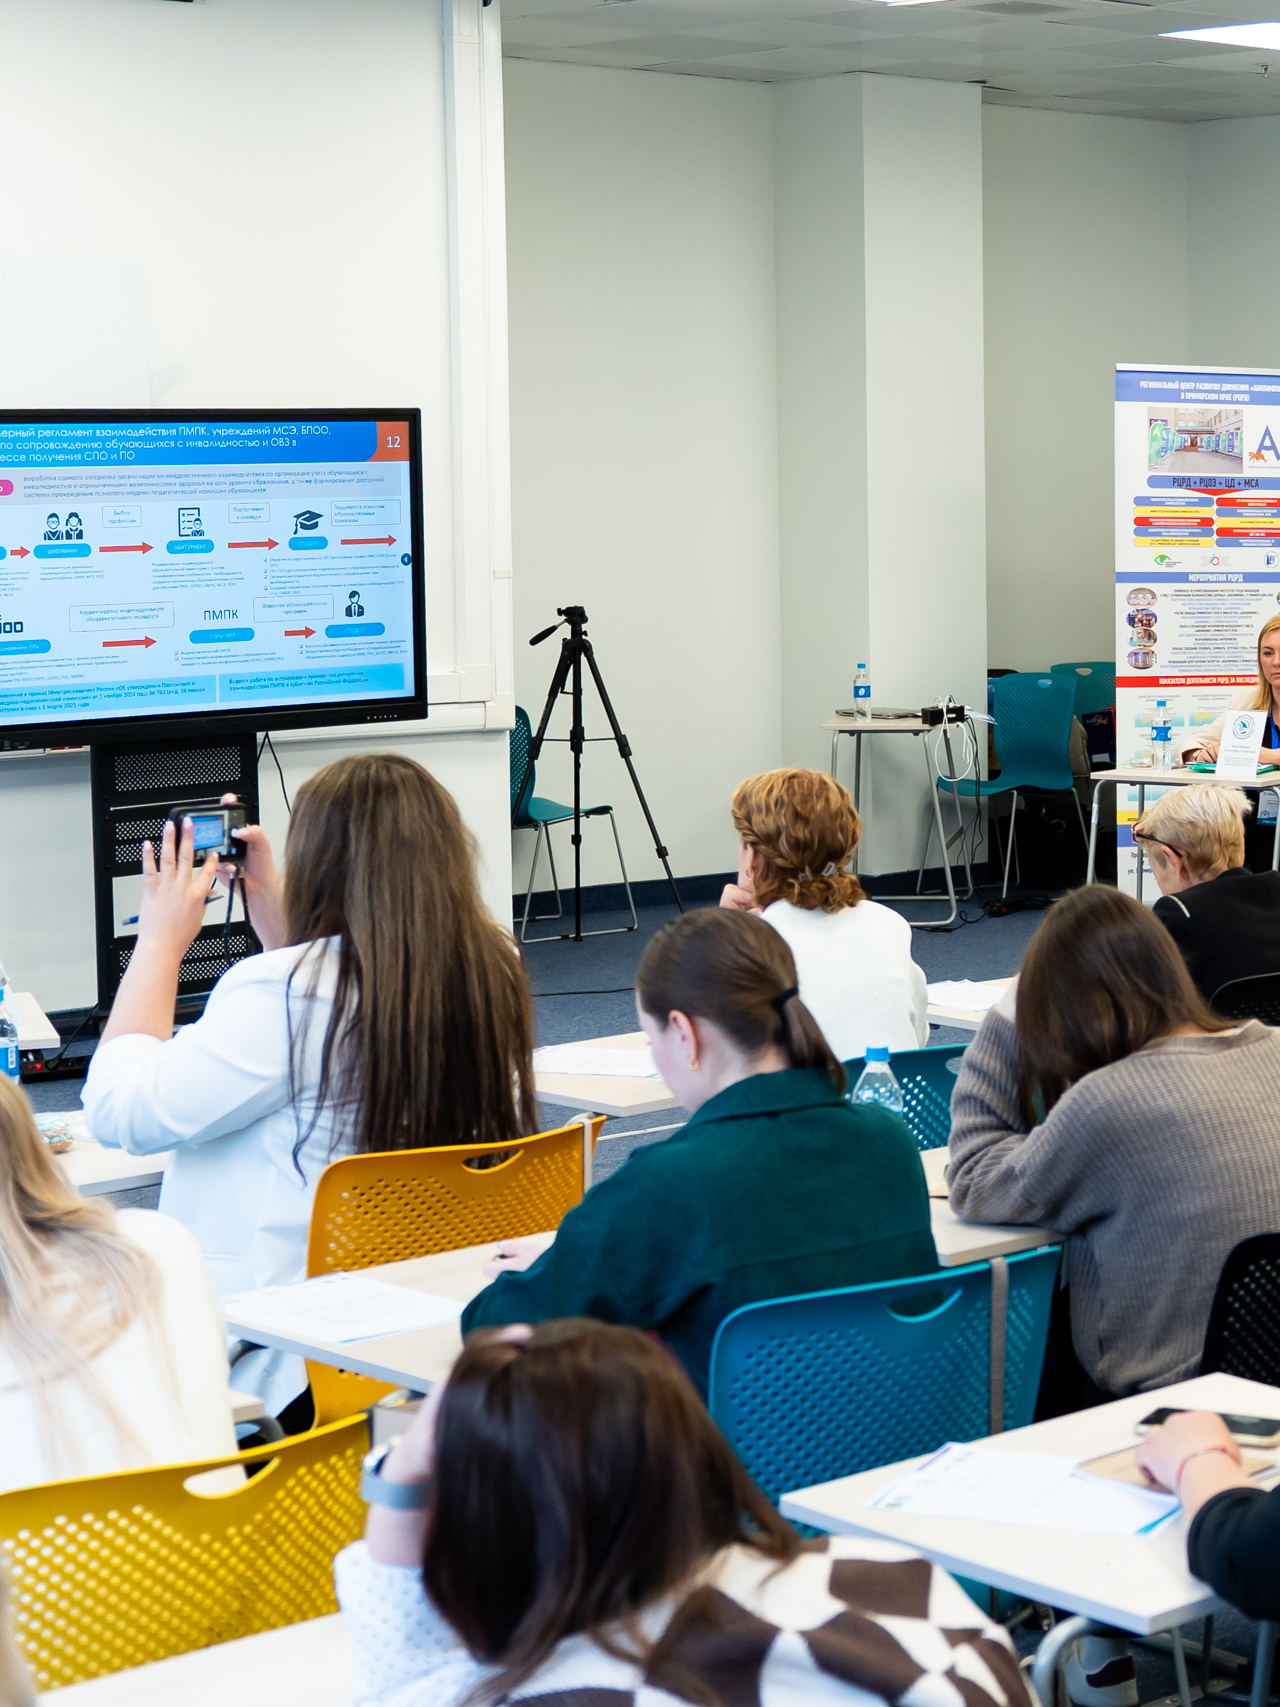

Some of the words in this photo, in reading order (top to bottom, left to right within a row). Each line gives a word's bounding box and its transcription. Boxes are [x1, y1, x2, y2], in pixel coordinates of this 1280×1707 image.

[1139, 380, 1180, 390] РЕГИОНАЛЬНЫЙ
[1180, 382, 1196, 391] ЦЕНТР
[1196, 382, 1221, 391] РАЗВИТИЯ
[1221, 383, 1250, 392] ДВИЖЕНИЯ
[1185, 392, 1219, 400] ПРИМОРСКОМ
[1219, 393, 1232, 401] КРАЕ
[0, 428, 35, 439] ерный
[38, 429, 93, 440] регламент
[96, 427, 177, 438] взаимодействия
[179, 426, 210, 437] ПМПК,
[212, 425, 270, 437] учреждений
[272, 425, 299, 436] МСЭ,
[301, 425, 331, 435] БПОО,
[1, 442, 13, 450] по
[16, 441, 103, 451] сопровождению
[105, 439, 175, 451] обучающихся
[186, 438, 260, 448] инвалидностью
[262, 439, 269, 447] и
[270, 438, 290, 447] ОВЗ
[387, 436, 401, 448] 12
[29, 453, 82, 463] получения
[84, 451, 108, 461] СПО
[119, 451, 136, 461] ПО
[1172, 477, 1192, 488] РЦРД
[1225, 478, 1236, 489] ЦД
[1244, 479, 1260, 488] МСА
[1188, 573, 1227, 582] МЕРОПРИЯТИЯ
[203, 608, 239, 621] ПМПК
[1159, 677, 1186, 685] ПОКАЗАТЕЛИ
[1186, 677, 1217, 685] ДЕЯТЕЛЬНОСТИ
